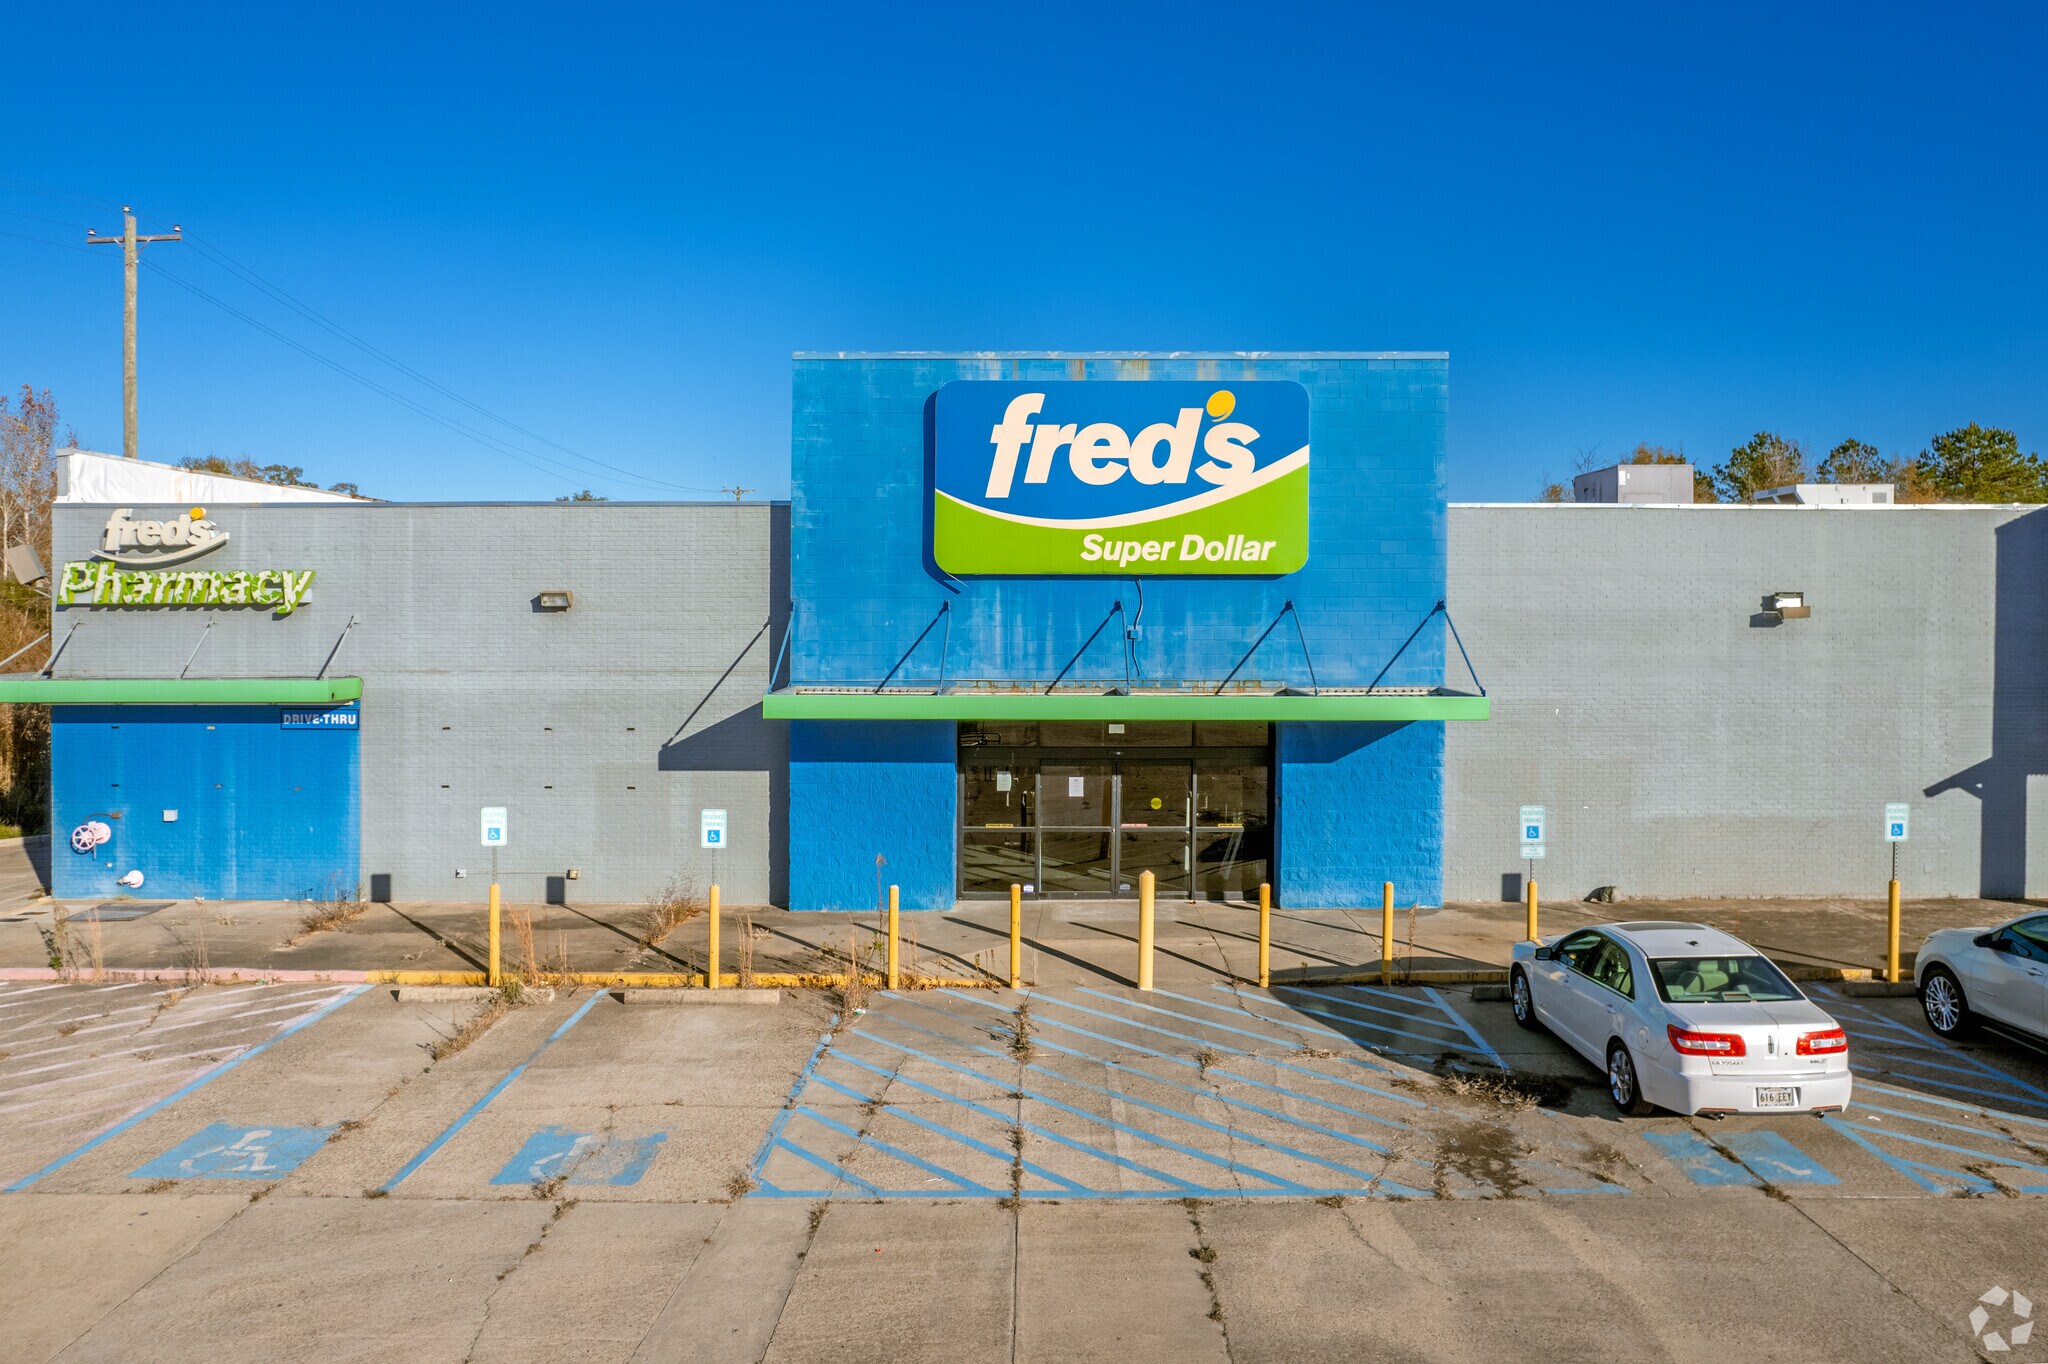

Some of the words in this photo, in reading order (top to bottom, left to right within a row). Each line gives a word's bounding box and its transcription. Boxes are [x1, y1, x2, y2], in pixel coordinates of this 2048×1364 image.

[985, 390, 1261, 499] fred's
[103, 507, 219, 552] fred's
[1080, 533, 1176, 567] Super
[1179, 534, 1277, 562] Dollar
[56, 560, 317, 614] Pharmacy
[282, 713, 357, 726] DRIVE-THRU
[1760, 1093, 1774, 1102] 616
[1778, 1092, 1792, 1102] EEY
